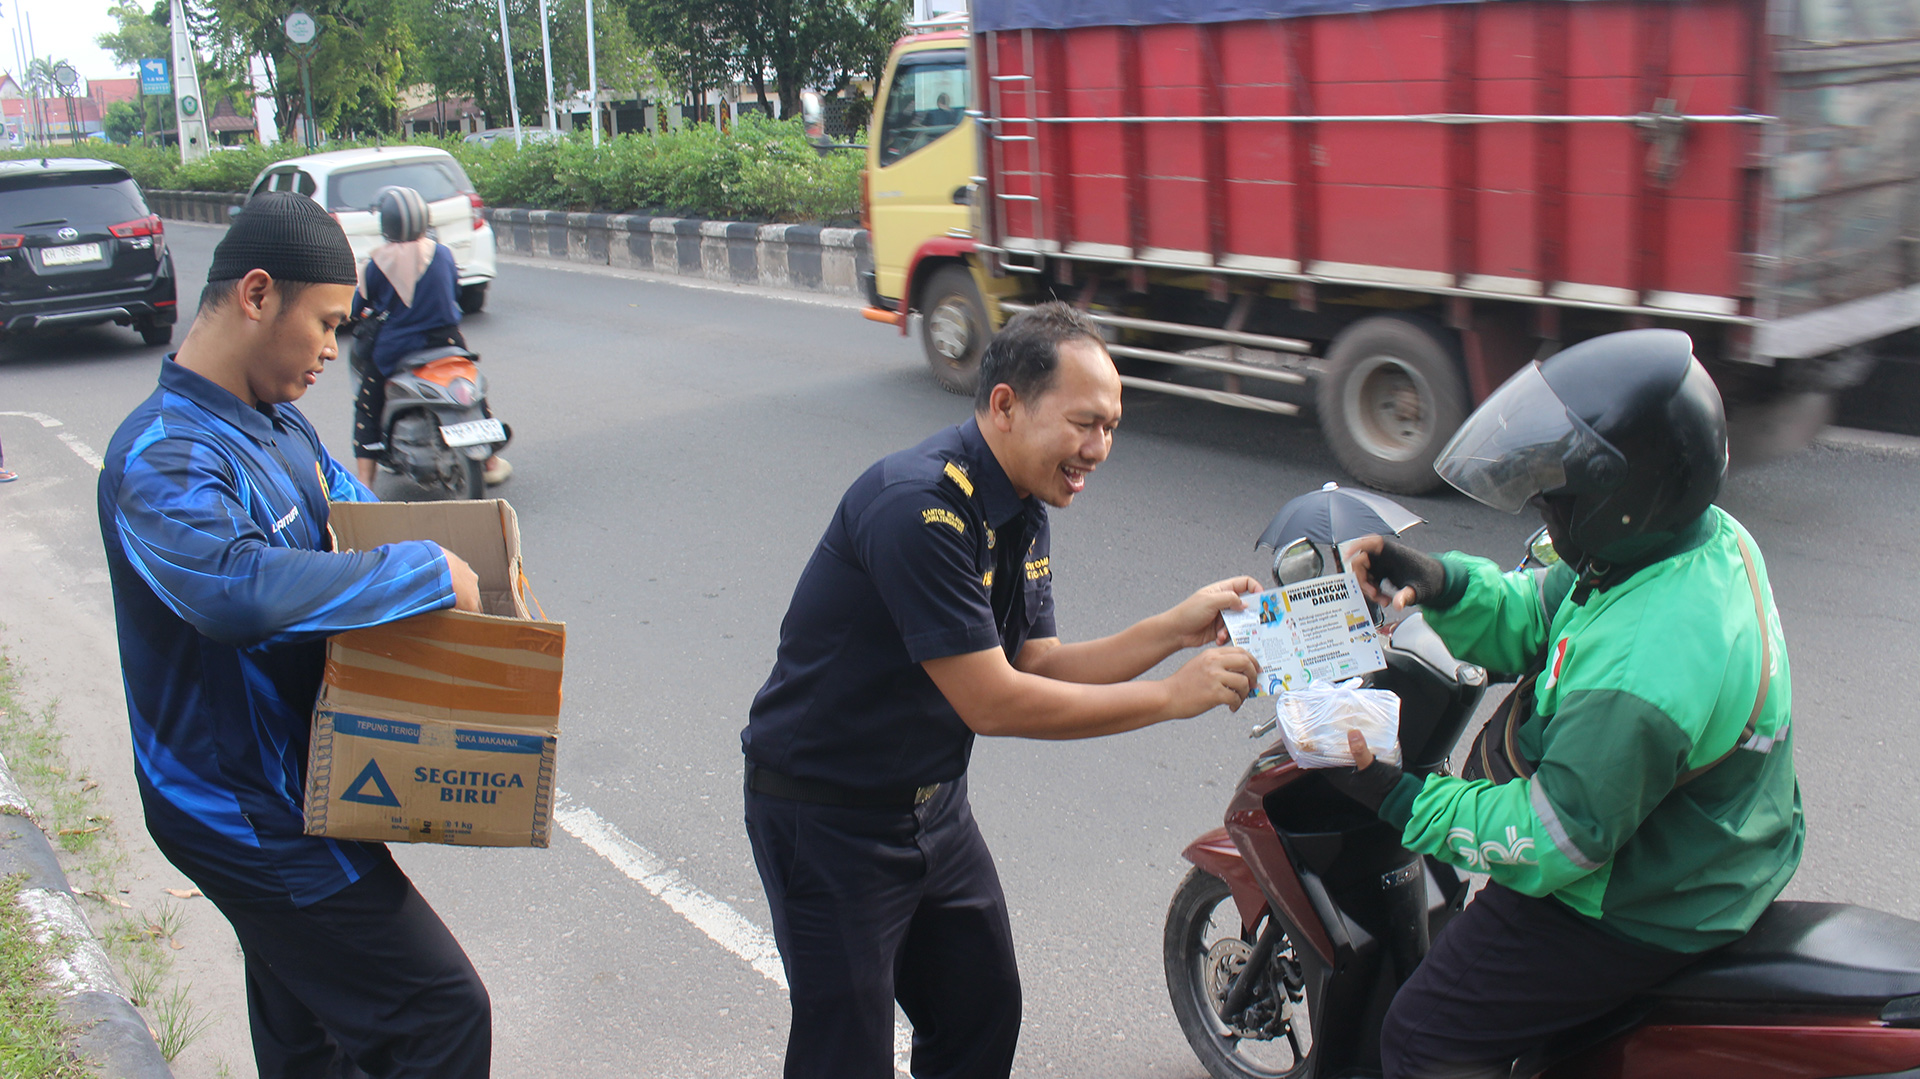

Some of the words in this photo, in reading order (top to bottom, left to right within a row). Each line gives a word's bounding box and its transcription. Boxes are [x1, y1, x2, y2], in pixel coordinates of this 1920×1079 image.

[1288, 582, 1347, 602] MEMBANGUN
[1312, 591, 1350, 606] DAERAH!
[357, 720, 388, 733] TEPUNG
[390, 725, 419, 737] TERIGU
[455, 733, 476, 745] NEKA
[478, 736, 518, 747] MAKANAN
[414, 766, 524, 788] SEGITIGA
[440, 786, 497, 805] BIRU
[461, 821, 473, 830] kg
